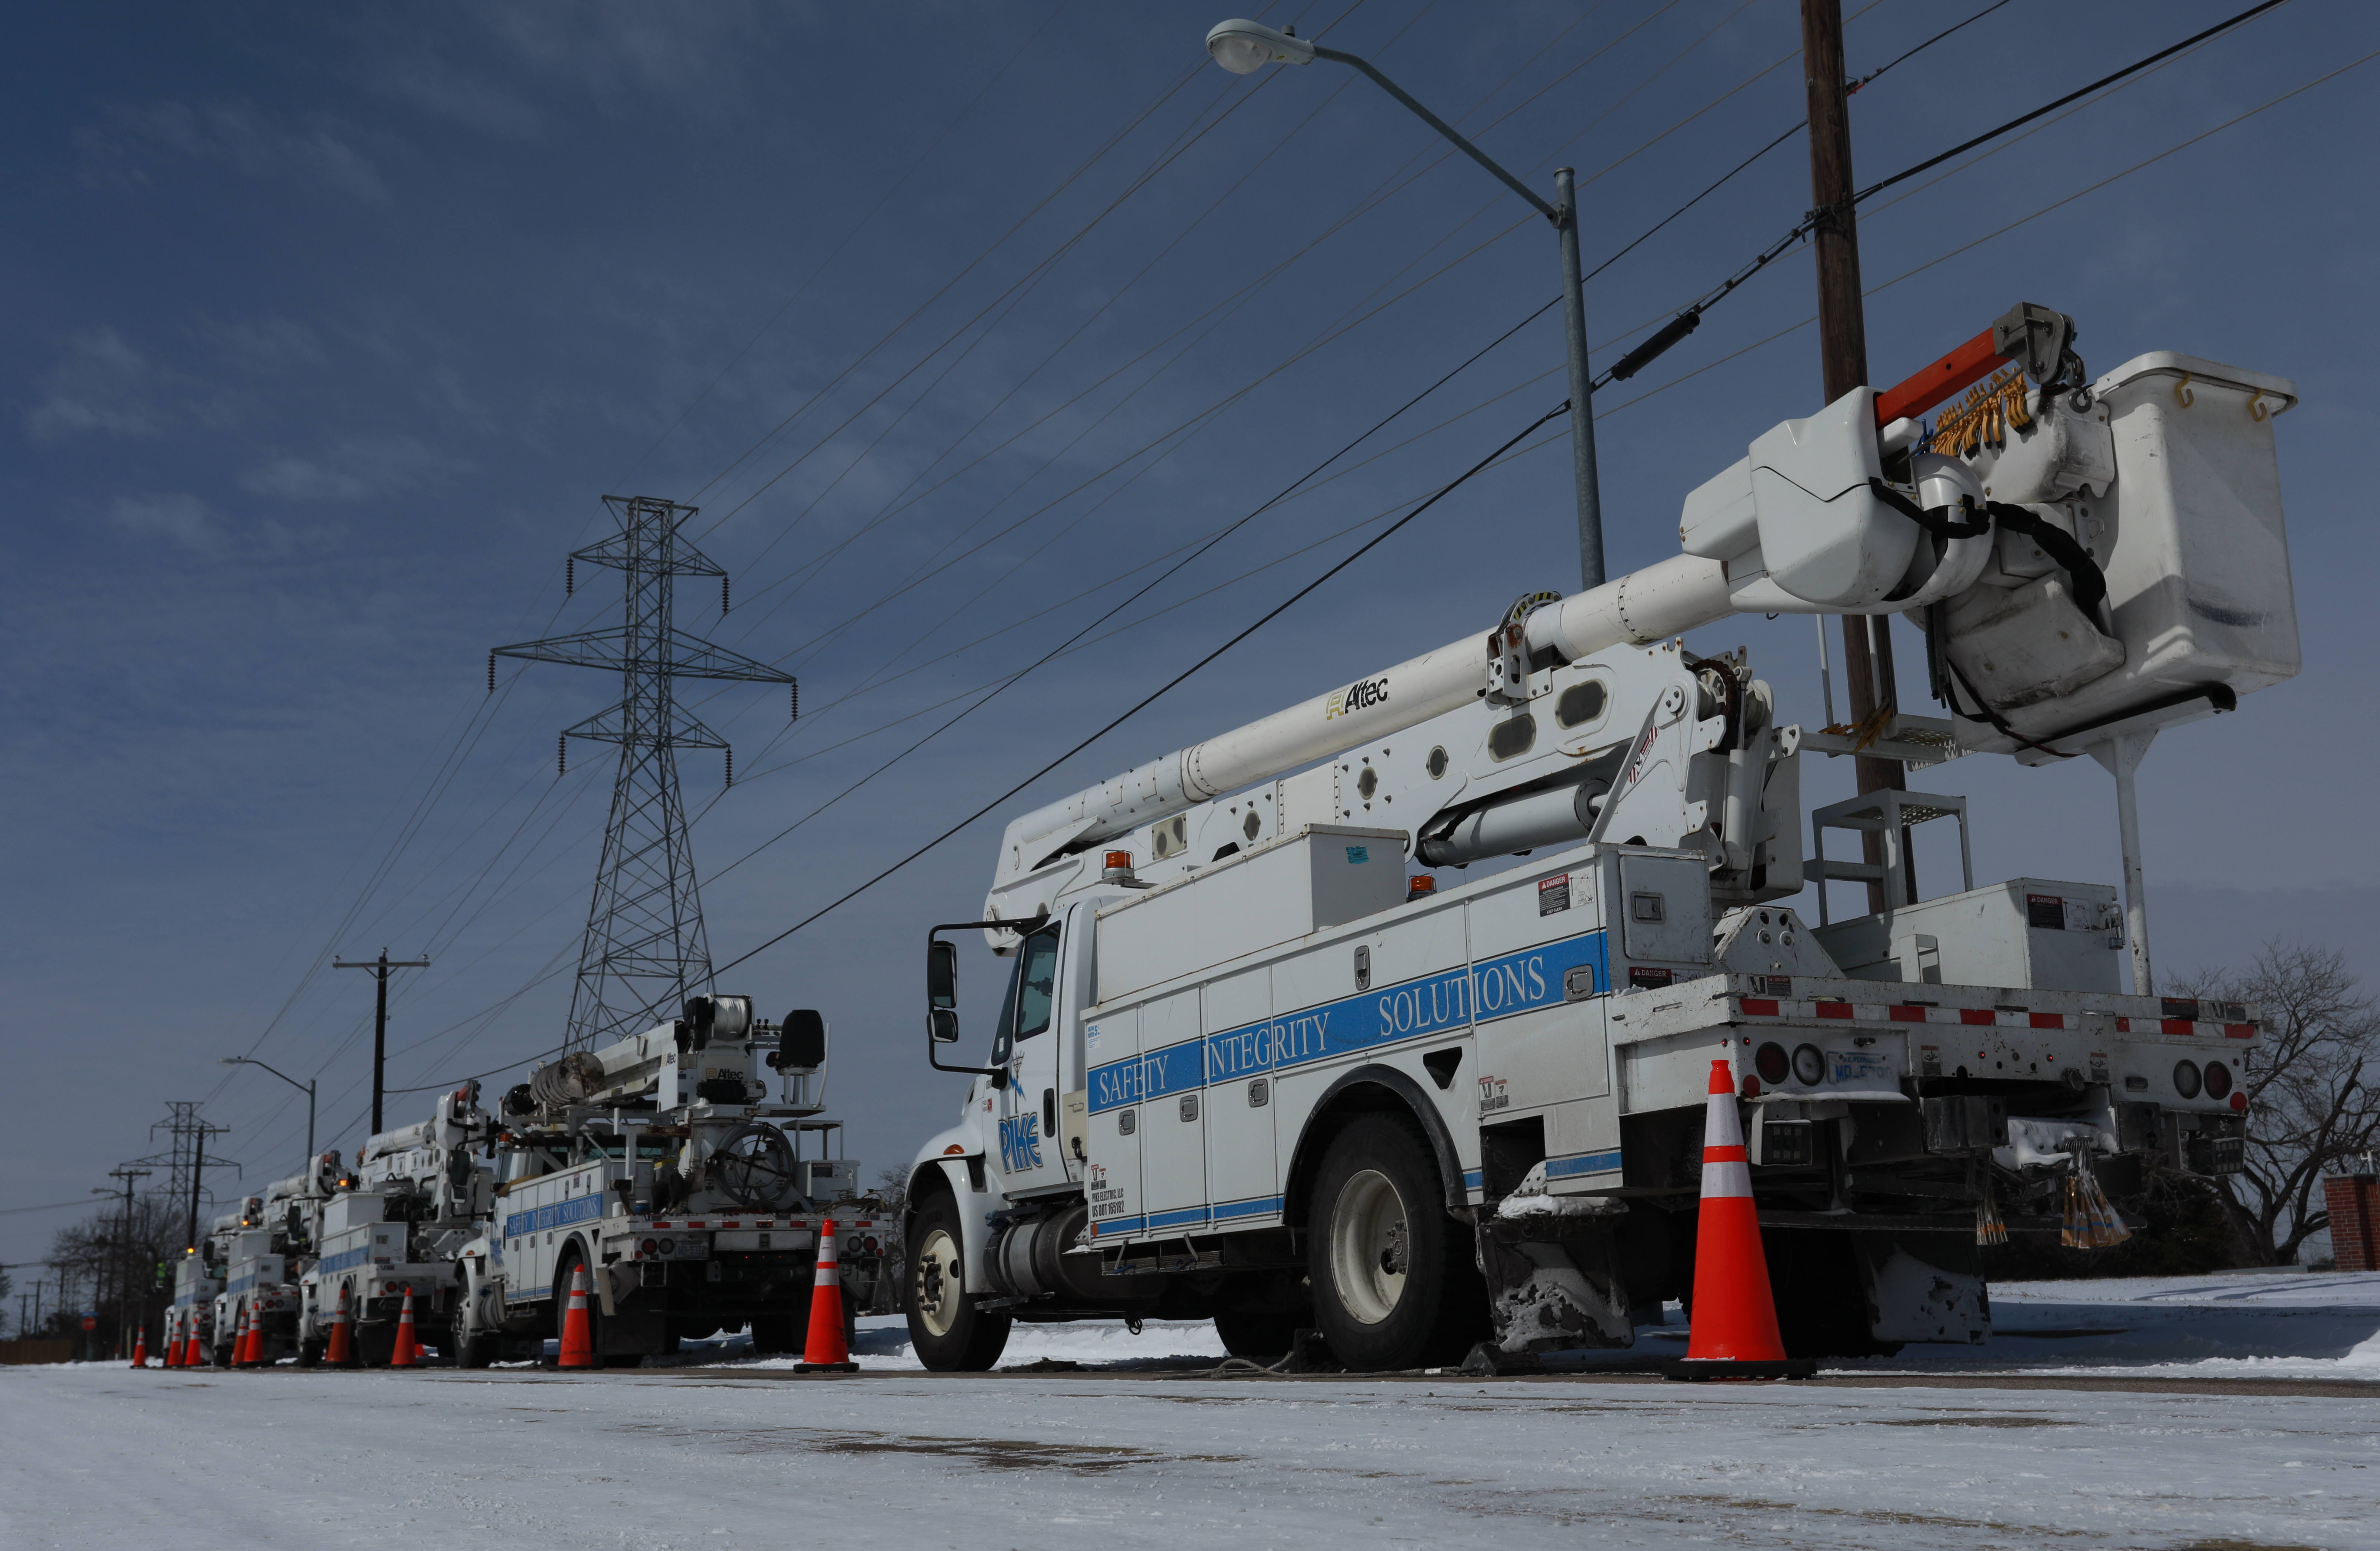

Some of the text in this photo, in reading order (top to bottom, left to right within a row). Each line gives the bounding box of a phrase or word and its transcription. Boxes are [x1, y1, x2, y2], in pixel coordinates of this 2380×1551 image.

[1344, 678, 1388, 714] Altec
[1546, 876, 1565, 887] DANGER
[1100, 955, 1545, 1105] SAFETY INTEGRITY SOLUTIONS
[666, 1053, 676, 1065] Altec
[717, 1068, 743, 1080] Altec
[999, 1112, 1044, 1174] PIKE
[1100, 1189, 1117, 1201] ELECTRIC,
[509, 1197, 597, 1234] SAFETY INTEGRITY SOLUTIONS
[1092, 1200, 1124, 1217] US DOT 165182
